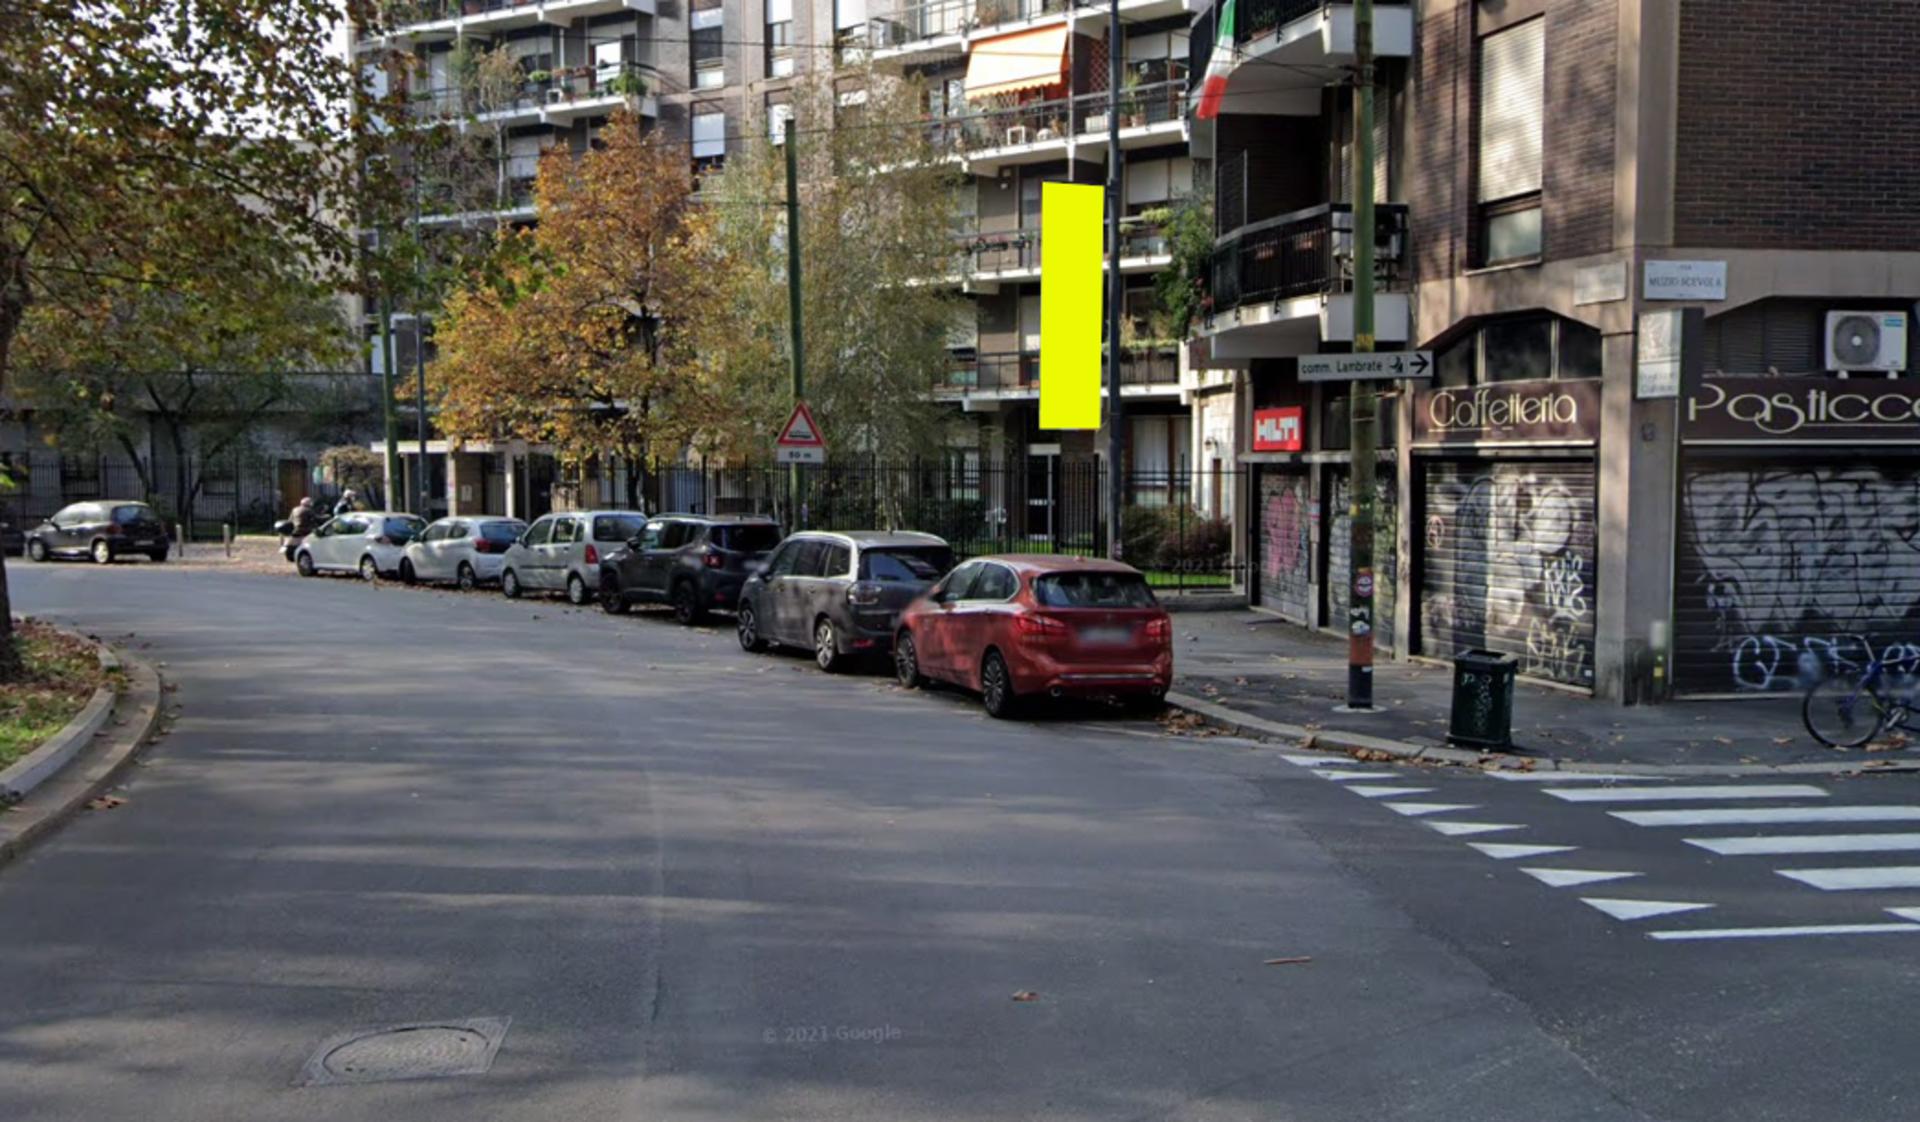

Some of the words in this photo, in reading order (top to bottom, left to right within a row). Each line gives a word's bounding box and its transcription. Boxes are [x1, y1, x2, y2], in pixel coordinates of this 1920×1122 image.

[1301, 363, 1331, 374] comm.
[1336, 361, 1383, 373] Lambrate
[1429, 389, 1577, 427] Caffetteria
[1688, 383, 1920, 434] Pasticc
[1256, 416, 1299, 442] HILTI
